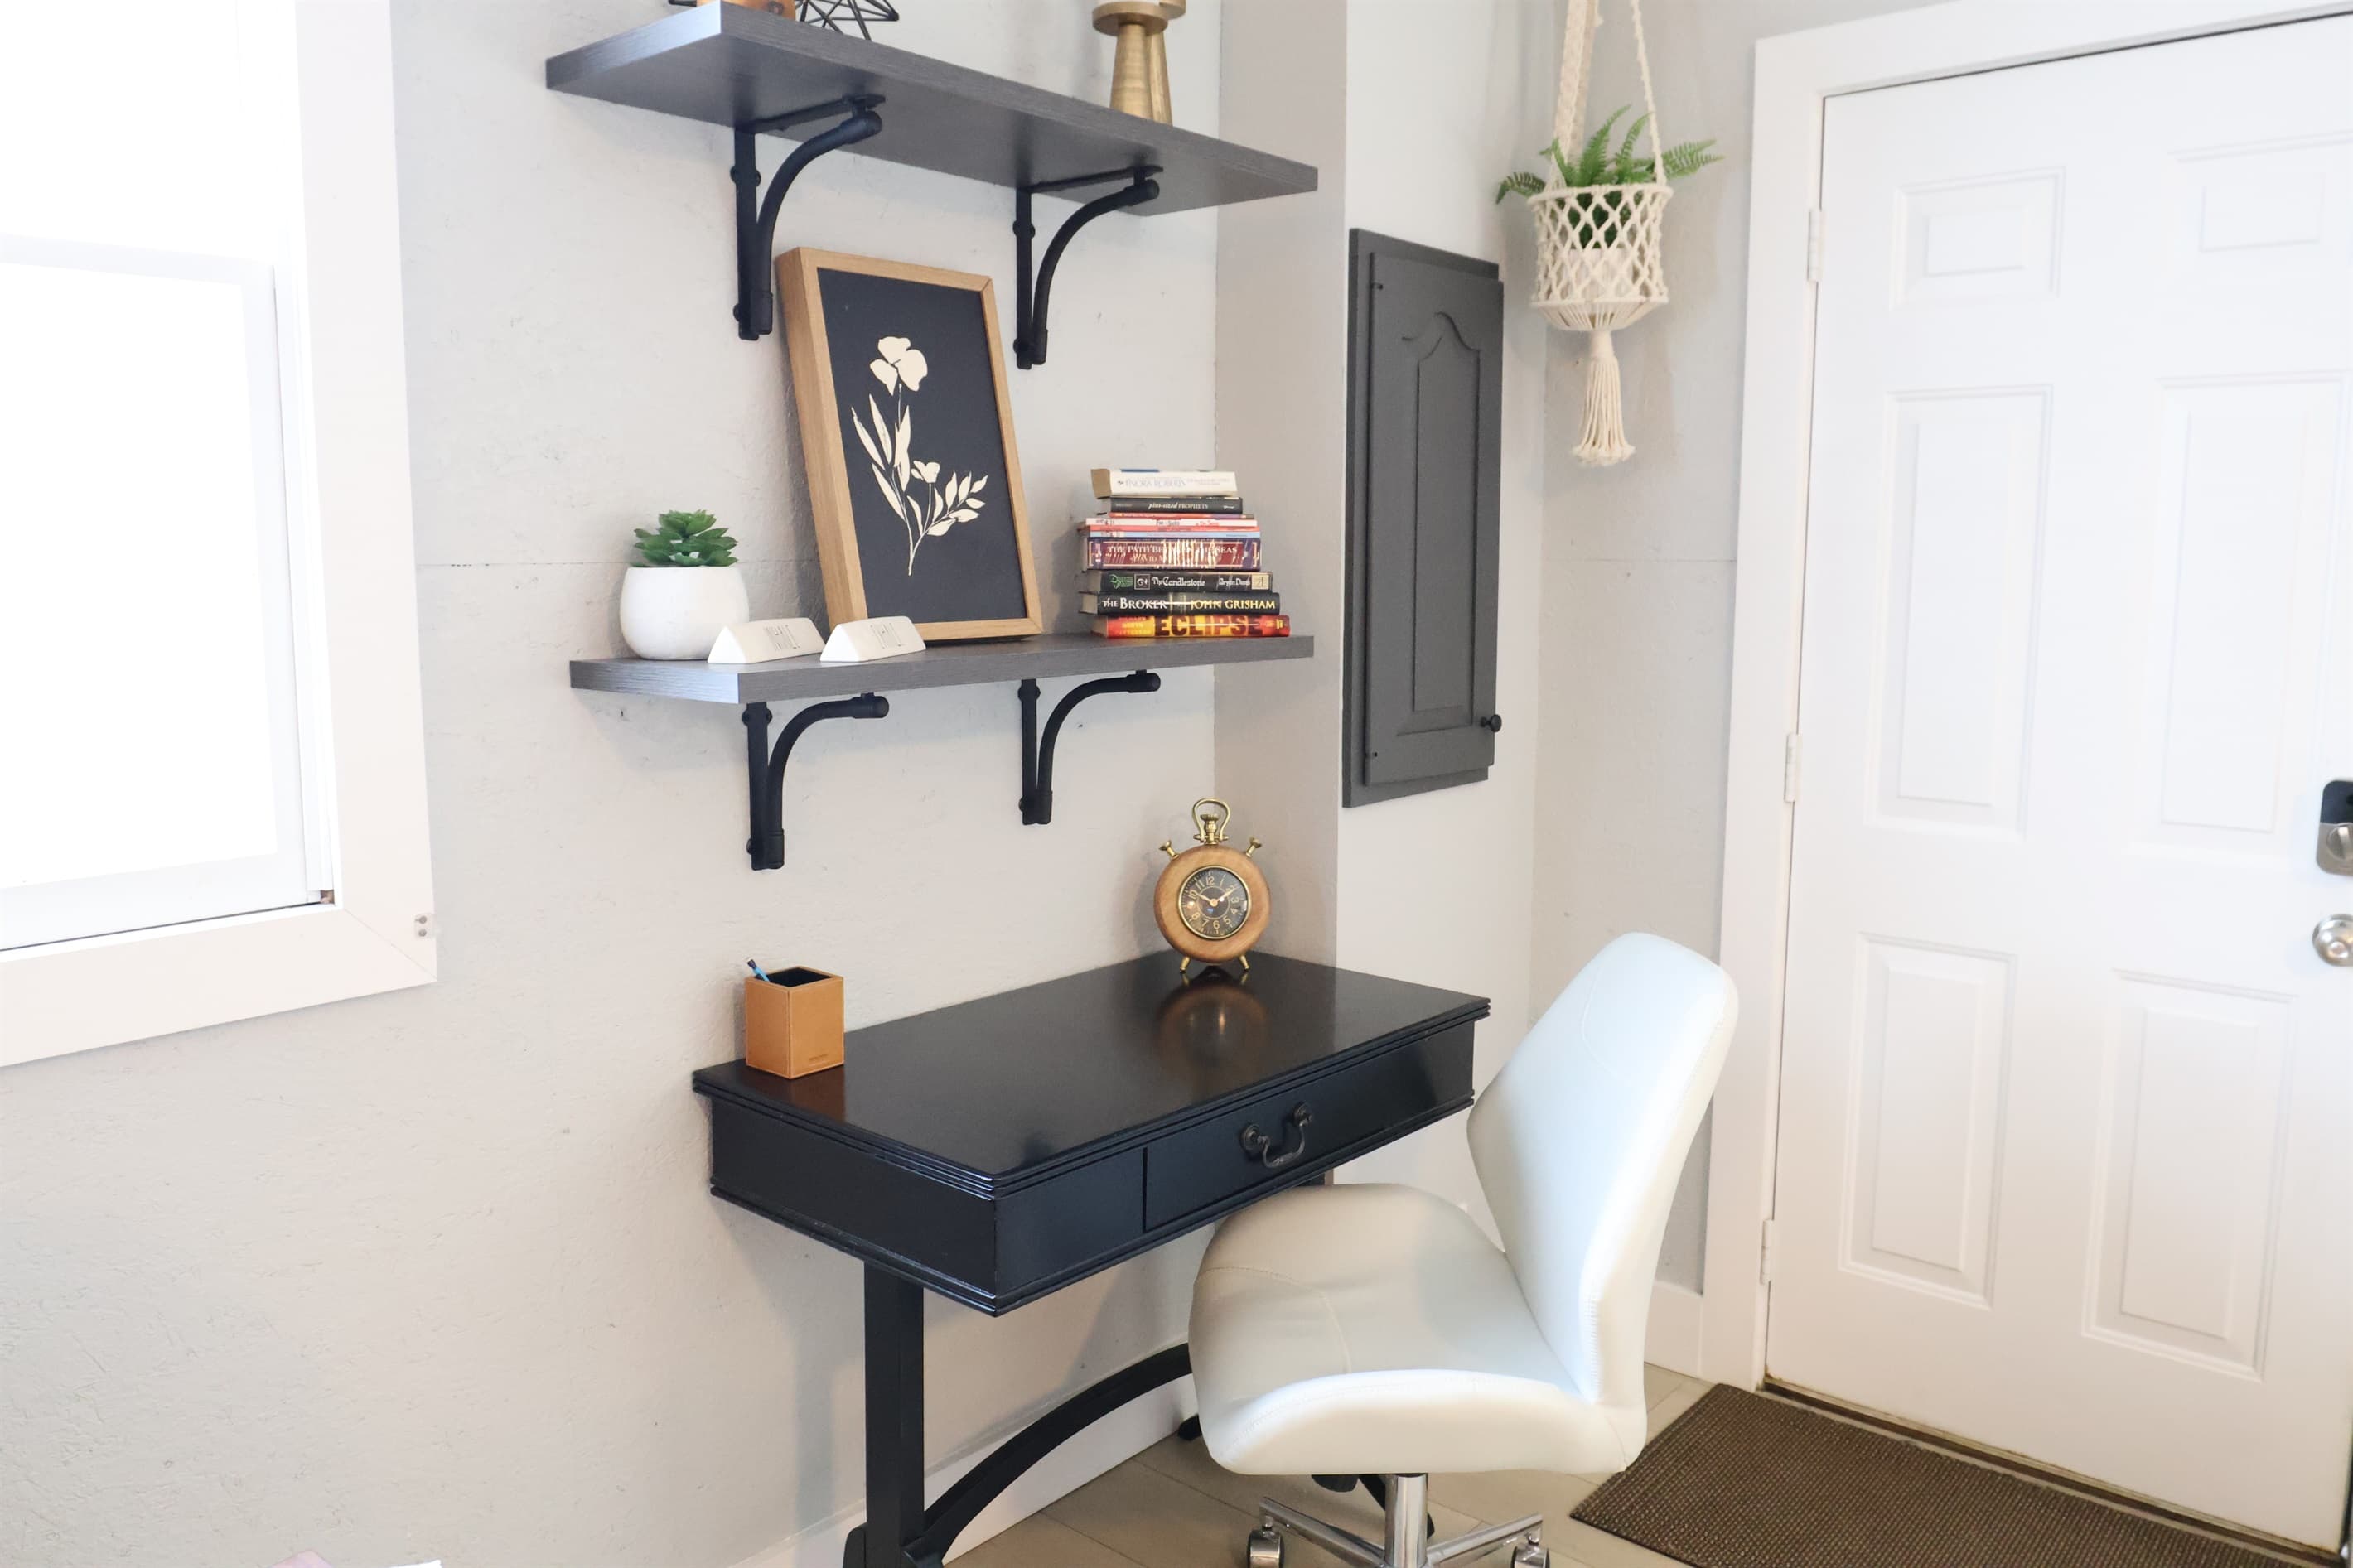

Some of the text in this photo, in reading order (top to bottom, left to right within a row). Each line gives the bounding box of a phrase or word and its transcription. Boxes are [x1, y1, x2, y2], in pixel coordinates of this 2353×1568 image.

[1162, 576, 1205, 587] Candlestone
[1102, 597, 1167, 610] THE BROKER
[1191, 599, 1276, 610] JOHN GRISHAM
[1155, 615, 1263, 636] ECLIPSE
